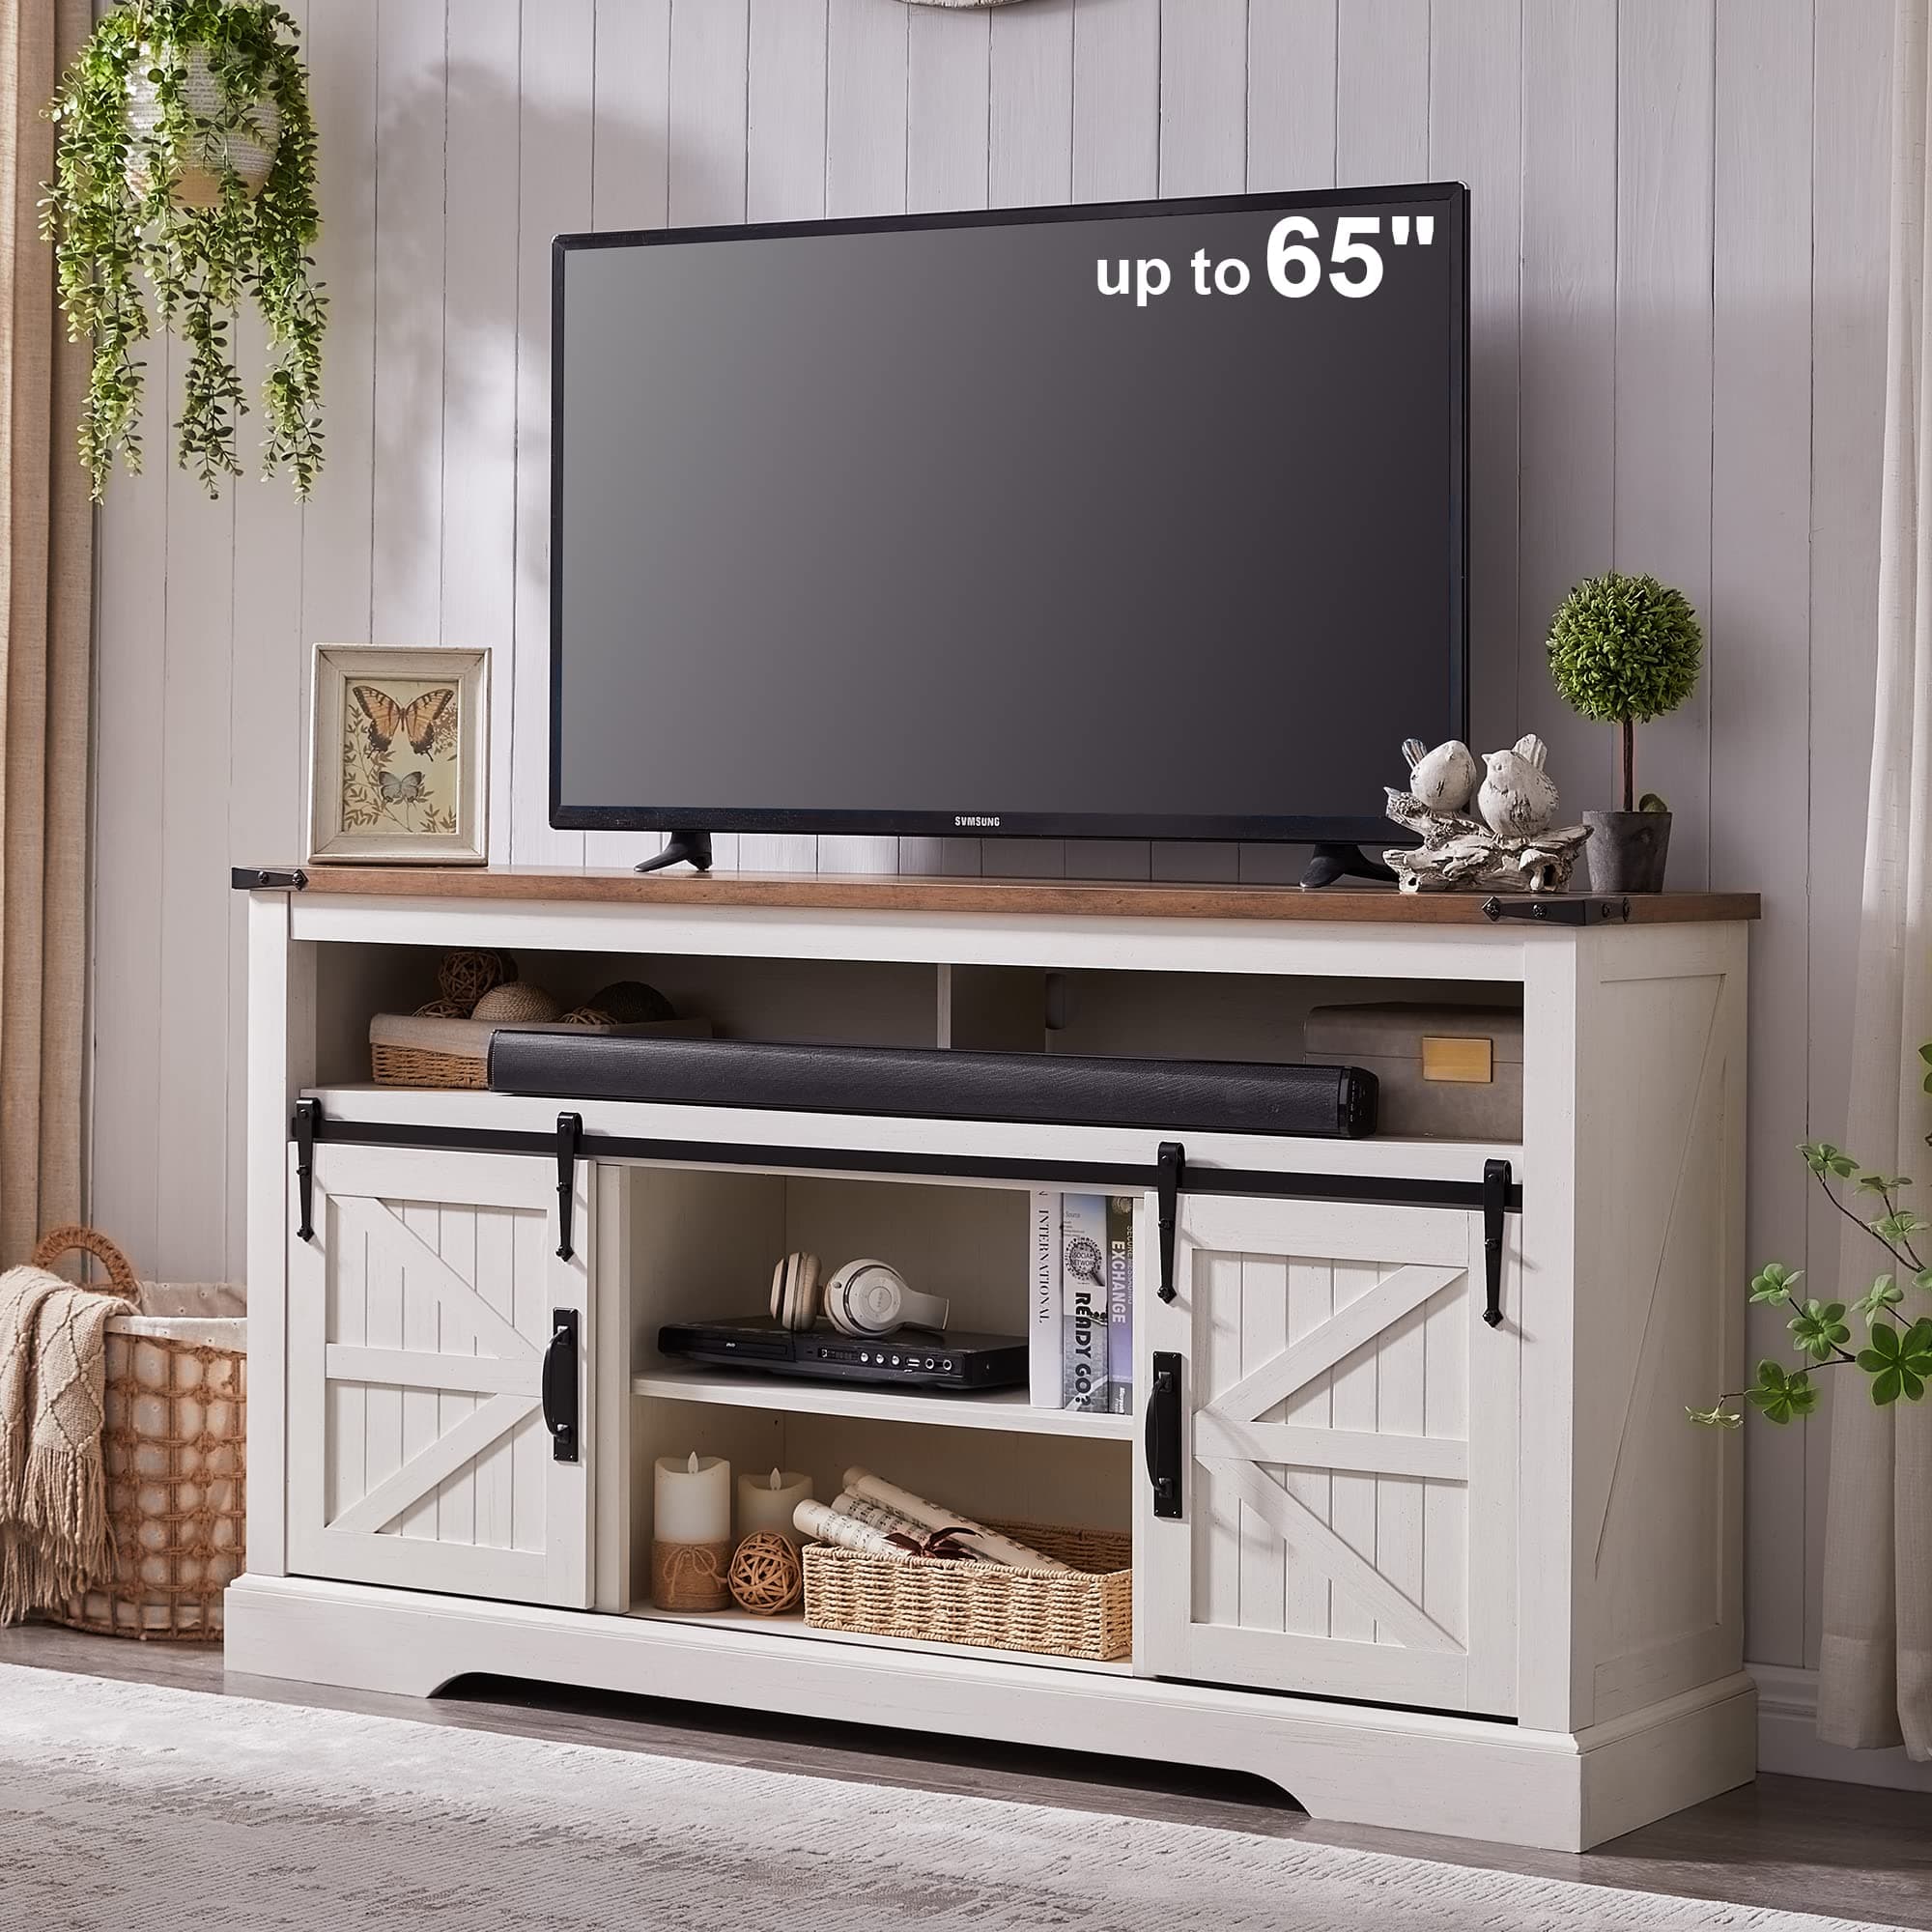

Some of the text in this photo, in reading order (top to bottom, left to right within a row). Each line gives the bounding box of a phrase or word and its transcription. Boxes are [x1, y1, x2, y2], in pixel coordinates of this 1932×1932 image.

[1038, 1209, 1050, 1324] INTERNATIONAL
[1111, 1240, 1126, 1323] EXCHANGE
[1075, 1293, 1092, 1359] READY
[1075, 1363, 1092, 1406] GO?
